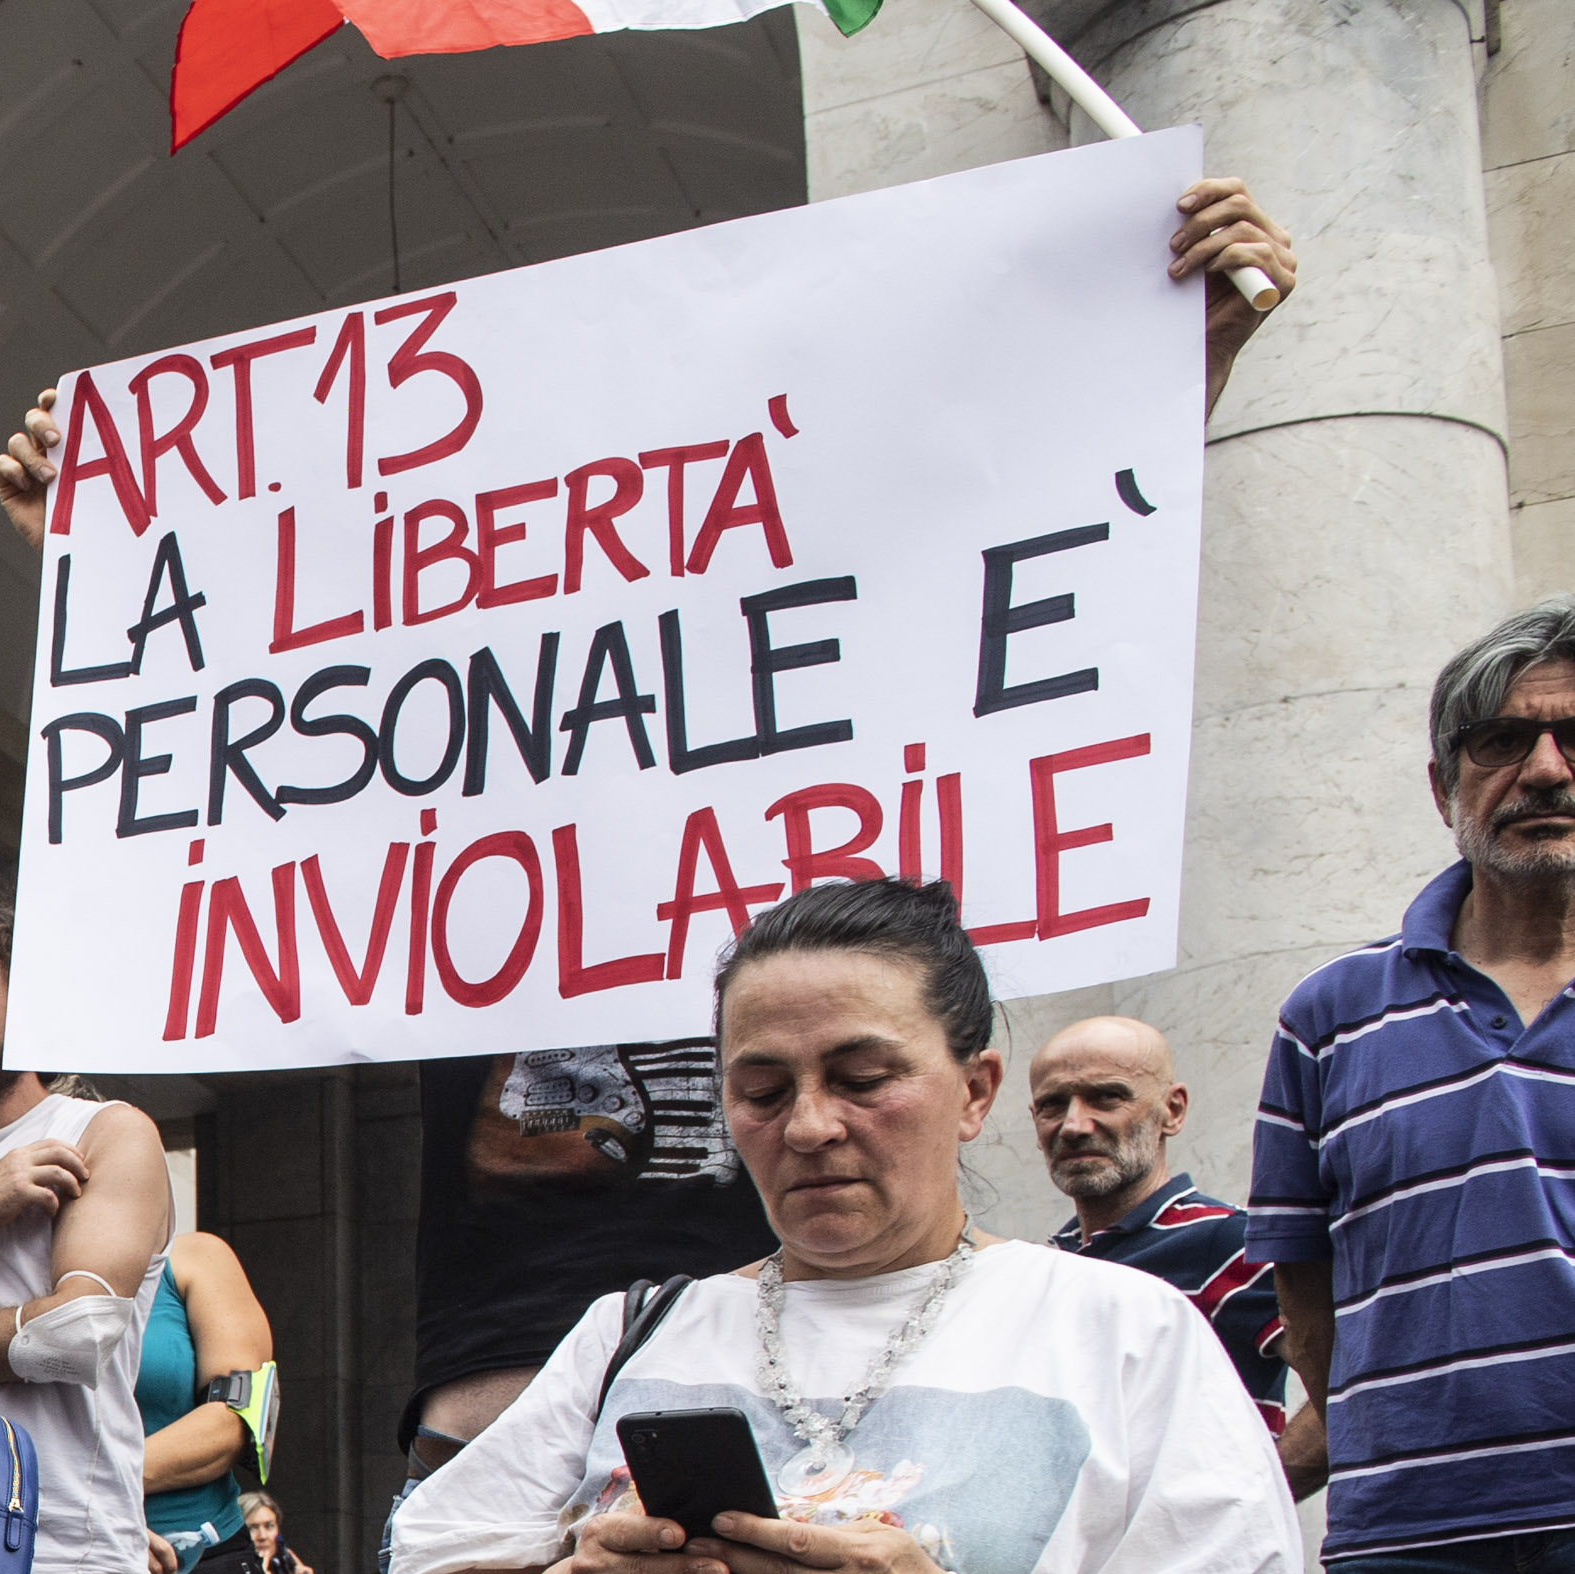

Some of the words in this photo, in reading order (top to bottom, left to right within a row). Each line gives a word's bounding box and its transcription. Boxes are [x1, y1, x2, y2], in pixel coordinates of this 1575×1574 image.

[40, 575, 858, 845] PERSONALE
[50, 530, 206, 687] LA
[162, 733, 1151, 1041] INVIOLABILE
